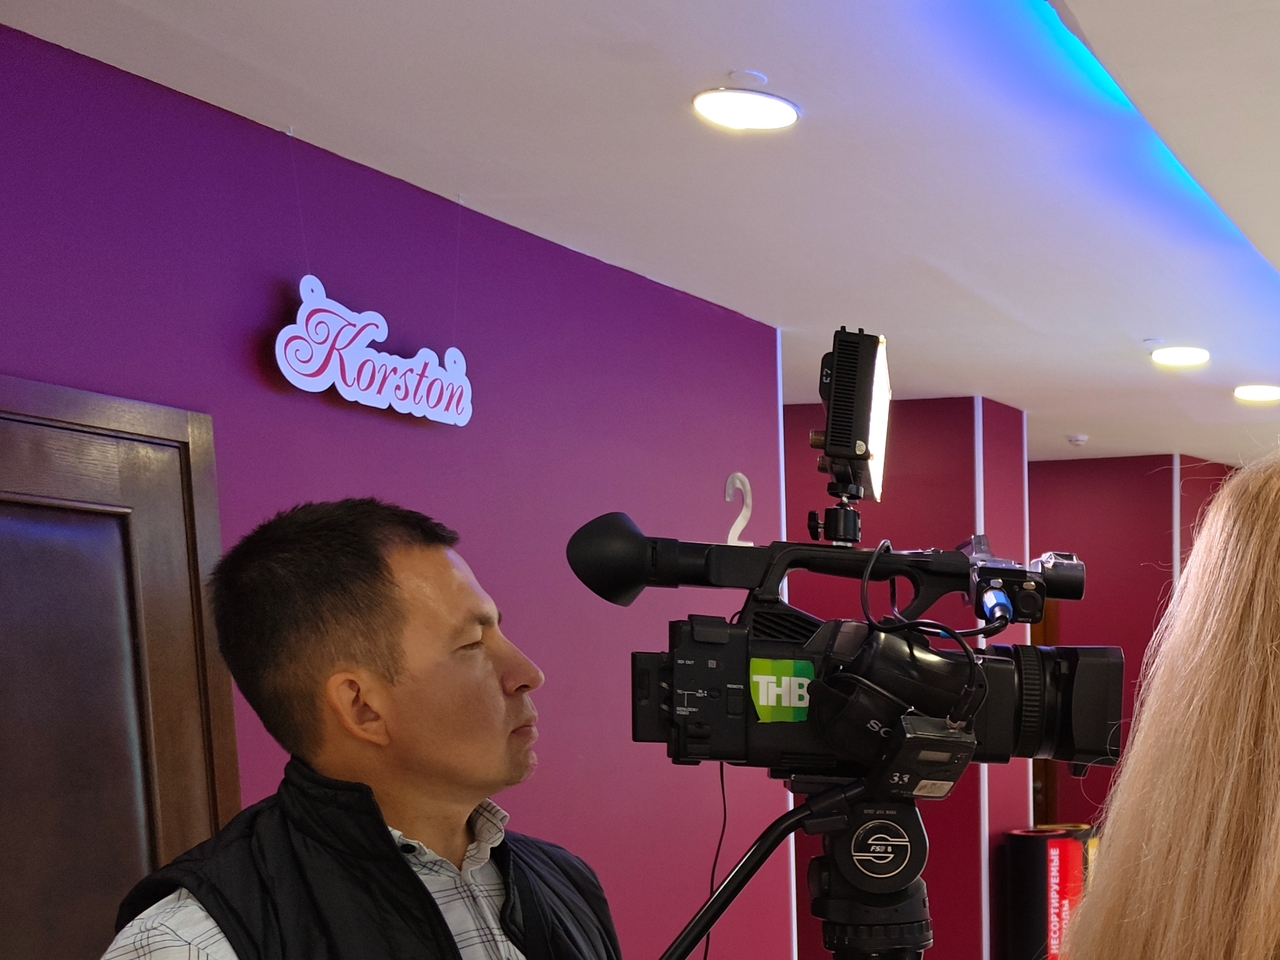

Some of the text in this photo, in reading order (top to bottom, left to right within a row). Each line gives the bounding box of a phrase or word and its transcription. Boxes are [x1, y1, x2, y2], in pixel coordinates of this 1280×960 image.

[283, 307, 465, 417] Korston
[752, 674, 811, 708] ТНВ
[1050, 847, 1060, 954] НЕСОРТИРУЕМЫЕ
